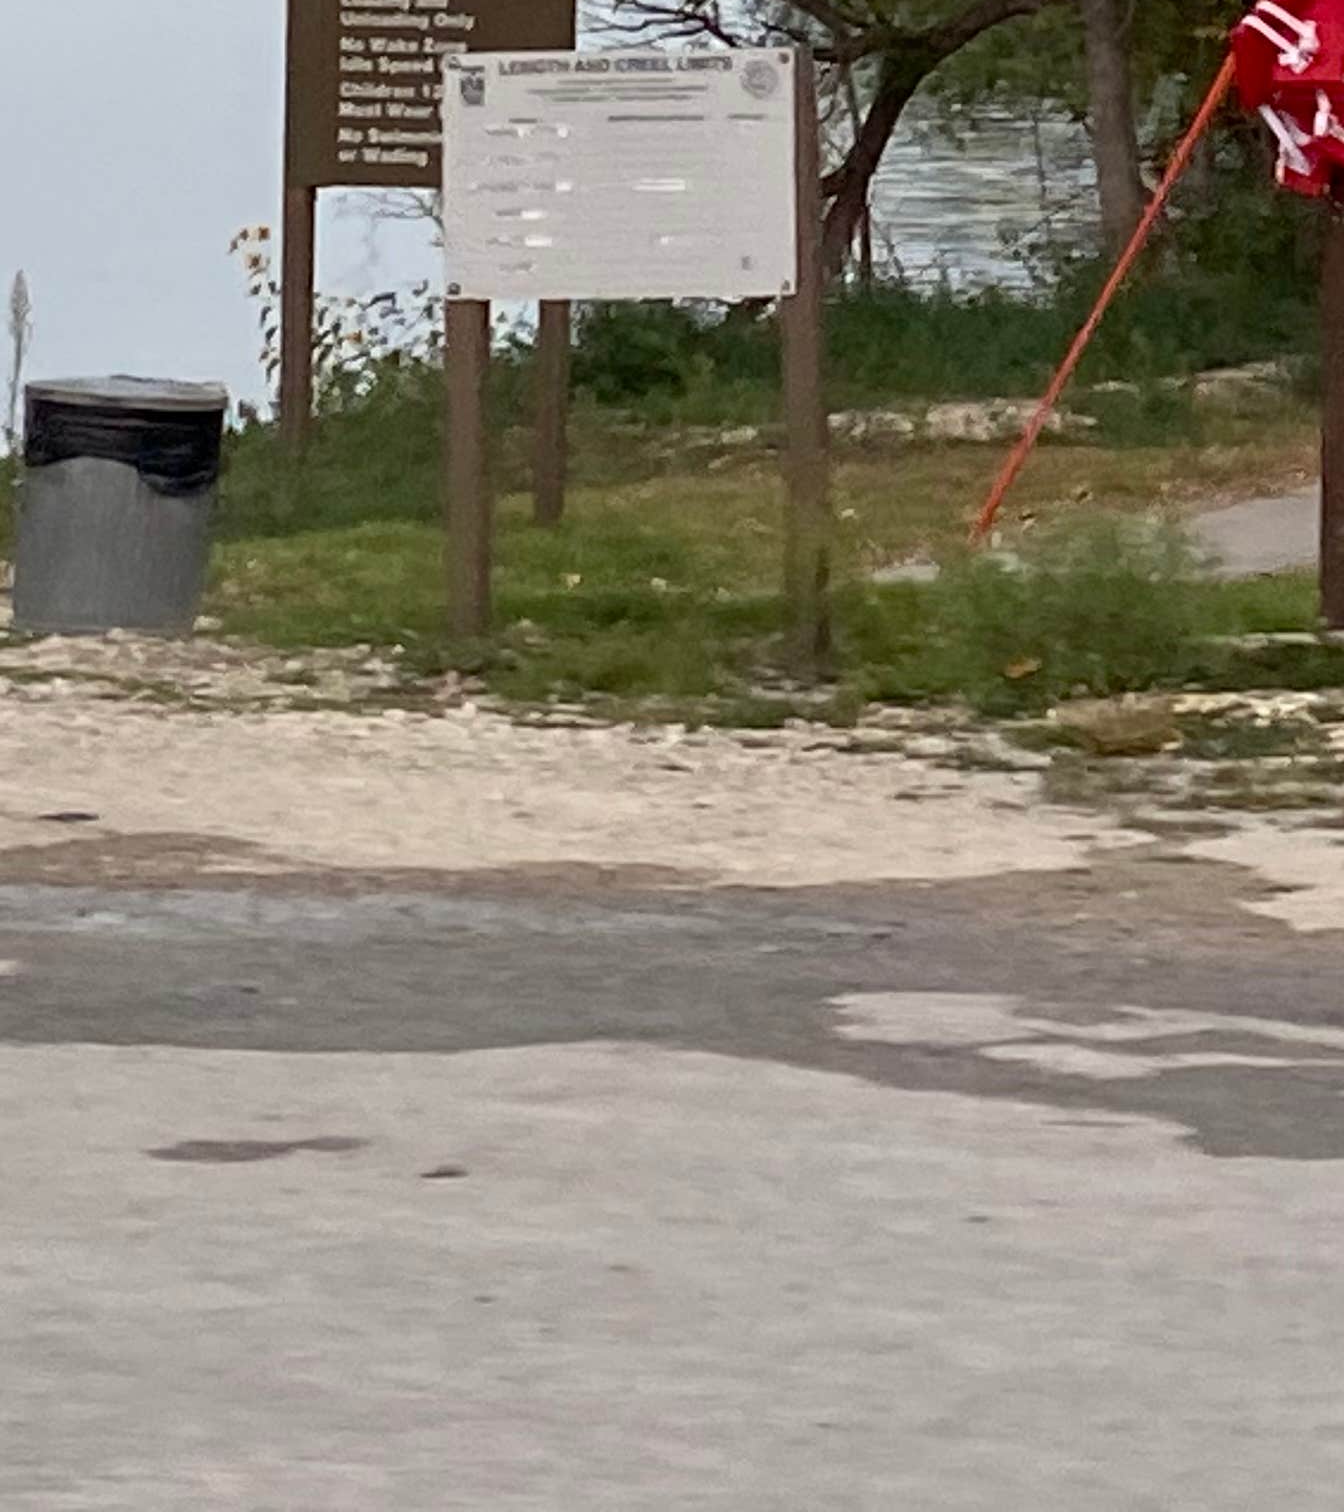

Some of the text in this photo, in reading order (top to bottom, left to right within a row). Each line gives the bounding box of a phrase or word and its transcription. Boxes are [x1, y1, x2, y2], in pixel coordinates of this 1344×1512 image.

[340, 11, 474, 31] Unloading Only
[340, 37, 467, 52] No Wake Zone
[378, 56, 434, 74] Speed
[499, 56, 733, 75] LENGTH AND CREEL LIMITS
[340, 82, 415, 99] Children
[339, 102, 433, 118] Must Wear
[338, 128, 363, 143] No
[363, 148, 428, 167] Wading
